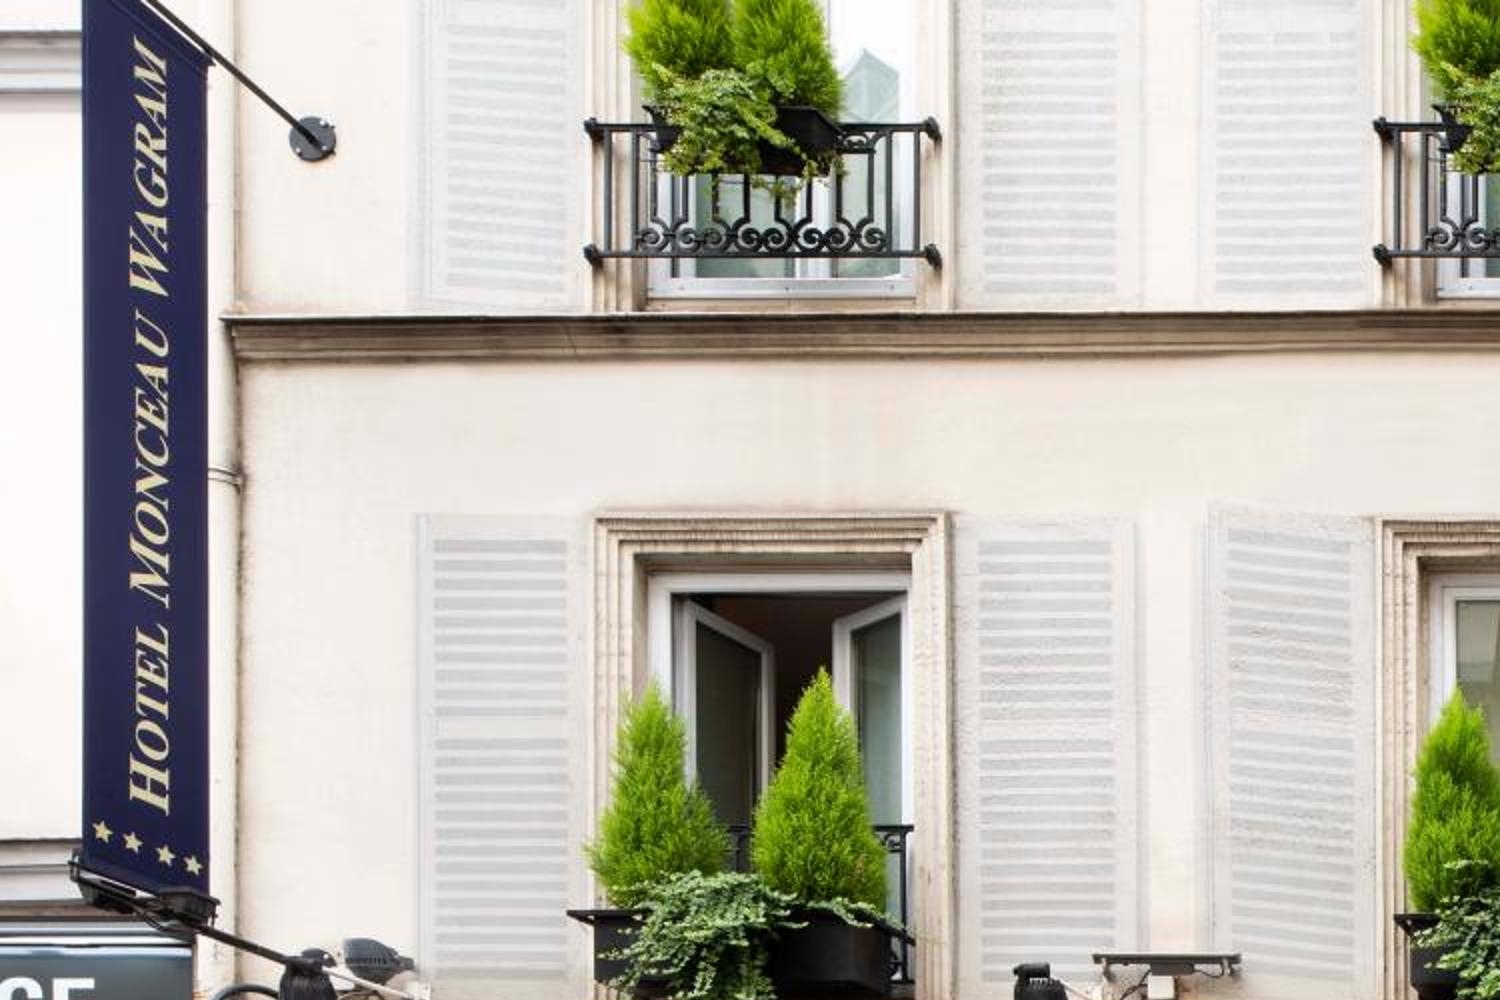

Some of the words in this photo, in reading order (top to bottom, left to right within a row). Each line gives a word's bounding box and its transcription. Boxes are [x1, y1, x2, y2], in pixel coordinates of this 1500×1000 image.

[129, 34, 169, 297] WAGRAM
[129, 308, 170, 609] MONCEAU
[129, 623, 170, 816] HOTEL
